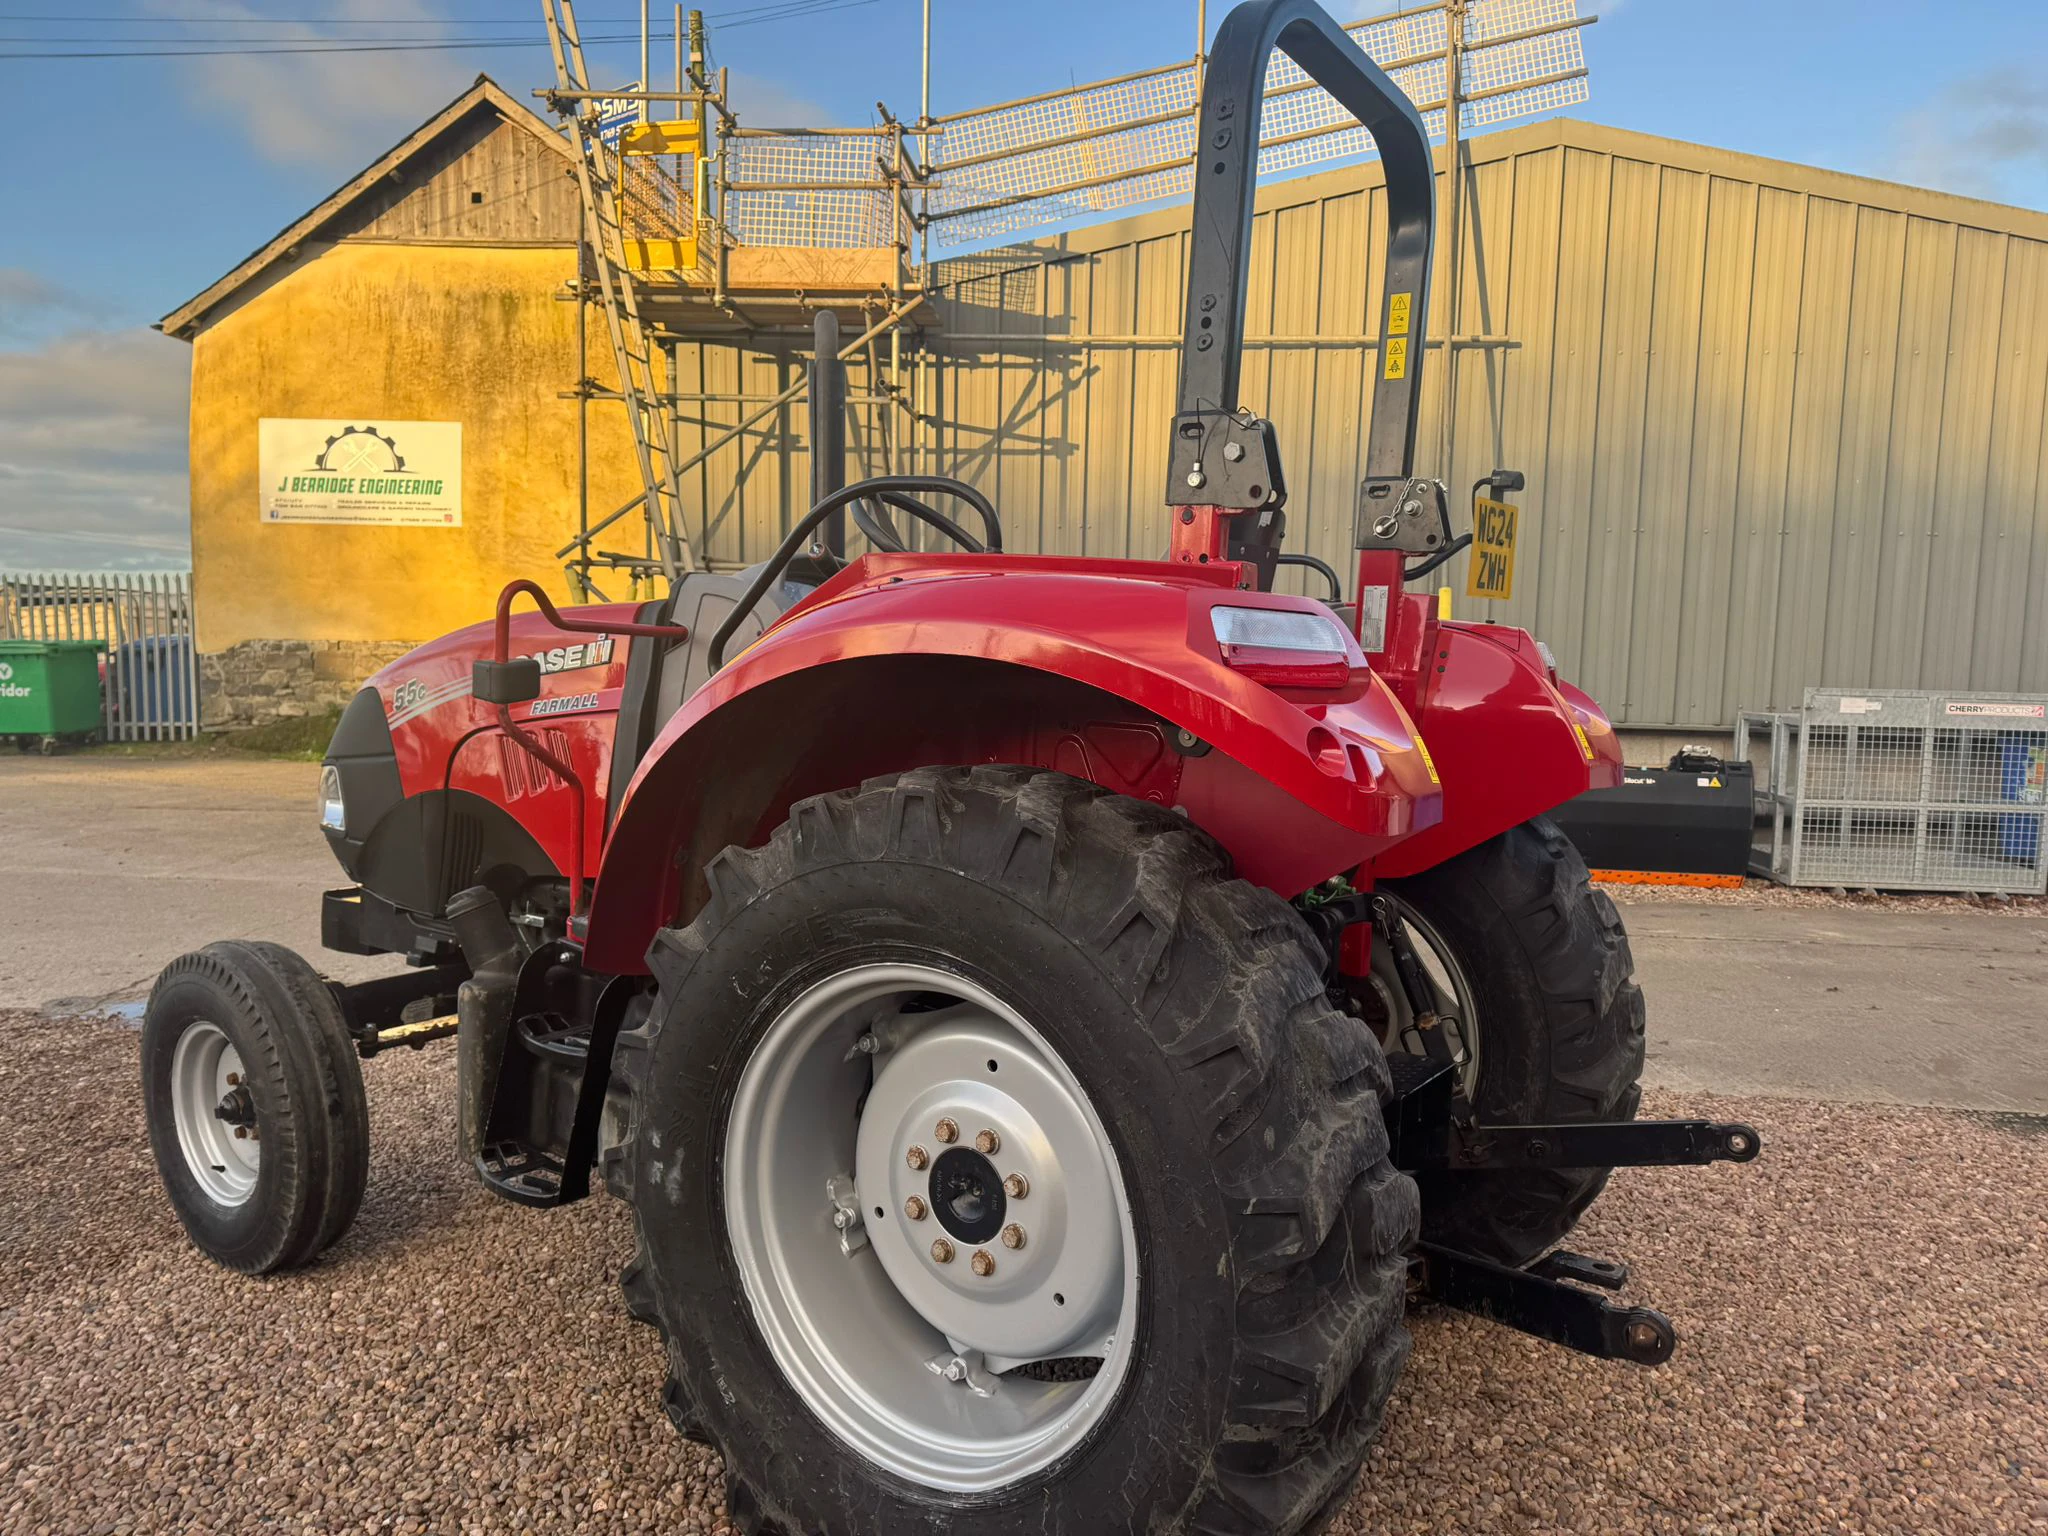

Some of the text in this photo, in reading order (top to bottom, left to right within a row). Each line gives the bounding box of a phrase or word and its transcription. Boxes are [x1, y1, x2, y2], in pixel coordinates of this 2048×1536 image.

[278, 476, 443, 495] J BERRIDGE ENGINEERING
[1477, 503, 1514, 548] WG24
[1476, 551, 1507, 592] ZWH
[515, 644, 584, 674] ASE
[0, 682, 32, 698] idor
[529, 693, 599, 716] FARMALL
